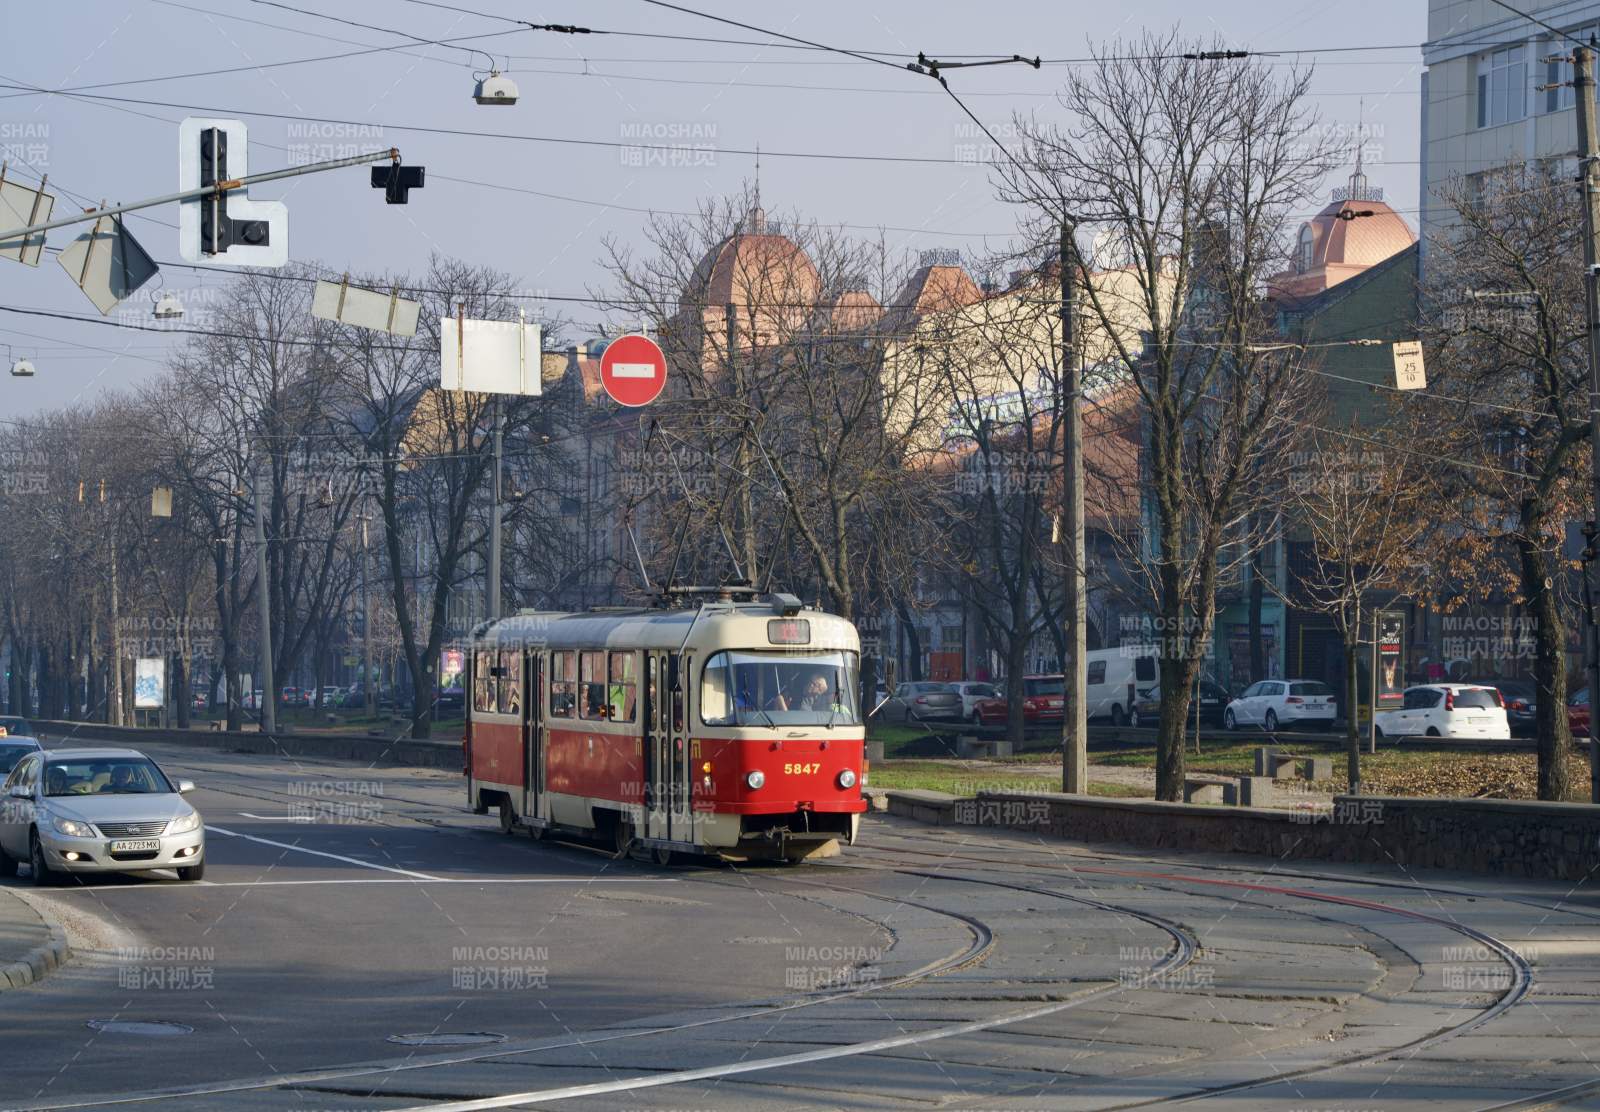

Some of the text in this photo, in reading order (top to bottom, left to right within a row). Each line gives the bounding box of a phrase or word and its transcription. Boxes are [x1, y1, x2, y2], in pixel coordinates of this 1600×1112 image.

[1404, 362, 1416, 372] 25
[1406, 374, 1416, 383] 10
[784, 763, 820, 775] 5847
